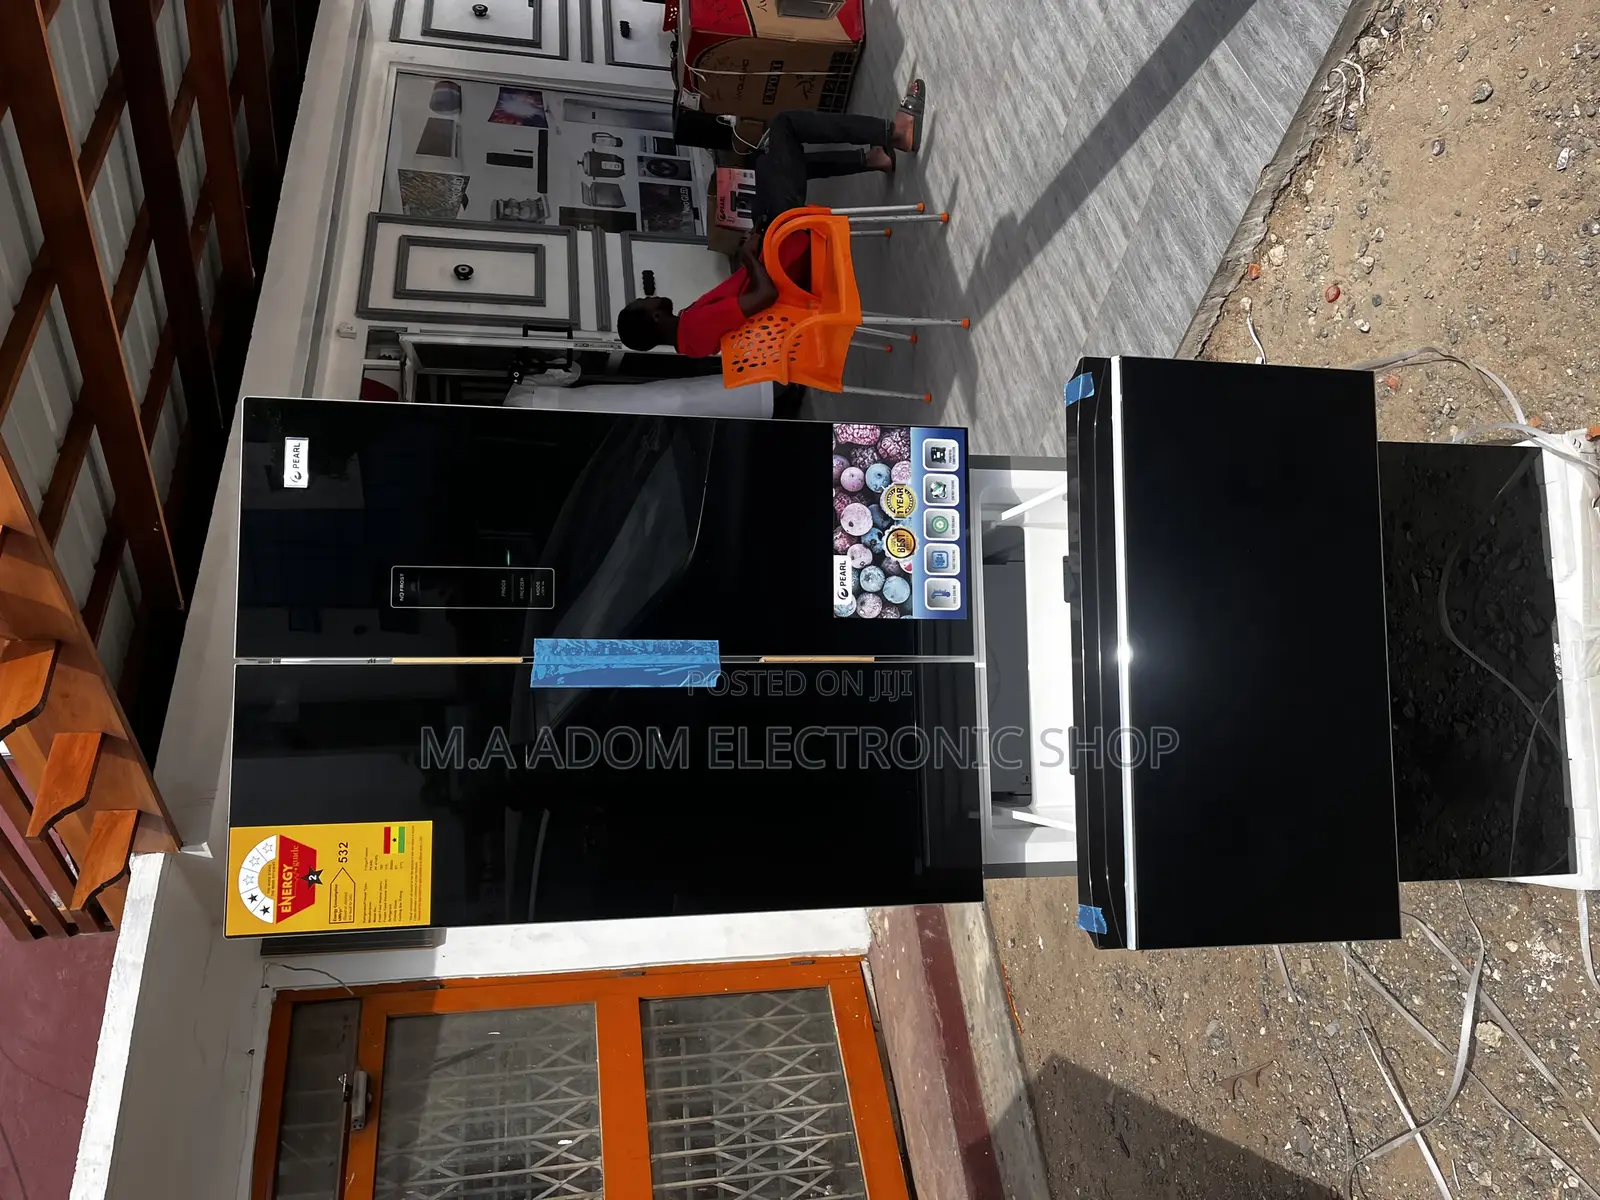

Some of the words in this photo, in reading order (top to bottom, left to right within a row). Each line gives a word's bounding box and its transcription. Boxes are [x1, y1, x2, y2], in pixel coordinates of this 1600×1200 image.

[680, 187, 689, 201] QLED
[681, 202, 690, 212] Neo
[292, 442, 300, 469] PEARL
[896, 488, 904, 509] YEAR
[897, 533, 906, 553] BEST
[839, 560, 847, 587] PEARL
[399, 592, 405, 602] NO
[291, 846, 300, 866] guide
[338, 842, 348, 863] 532
[278, 864, 296, 913] ENERGY
